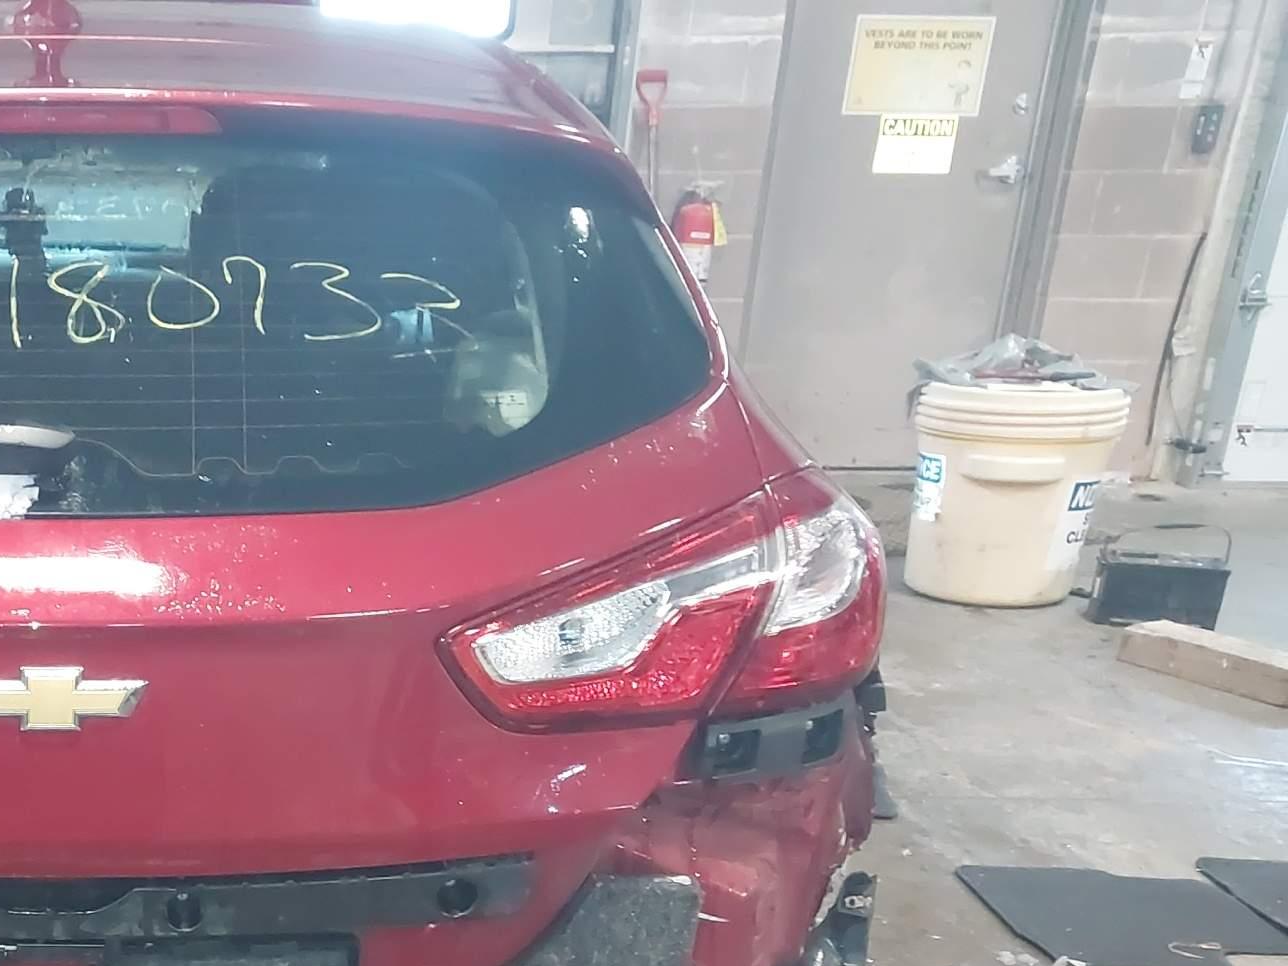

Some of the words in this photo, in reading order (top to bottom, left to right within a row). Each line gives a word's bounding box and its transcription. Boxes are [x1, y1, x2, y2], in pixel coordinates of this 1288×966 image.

[865, 30, 895, 38] VESTS
[897, 30, 917, 38] ARE
[921, 31, 934, 39] TO
[936, 31, 948, 39] BE
[951, 31, 984, 40] WORN
[874, 41, 917, 49] BEYOND
[919, 42, 940, 50] THIS
[943, 42, 972, 50] POINT
[882, 119, 953, 136] CAUTION
